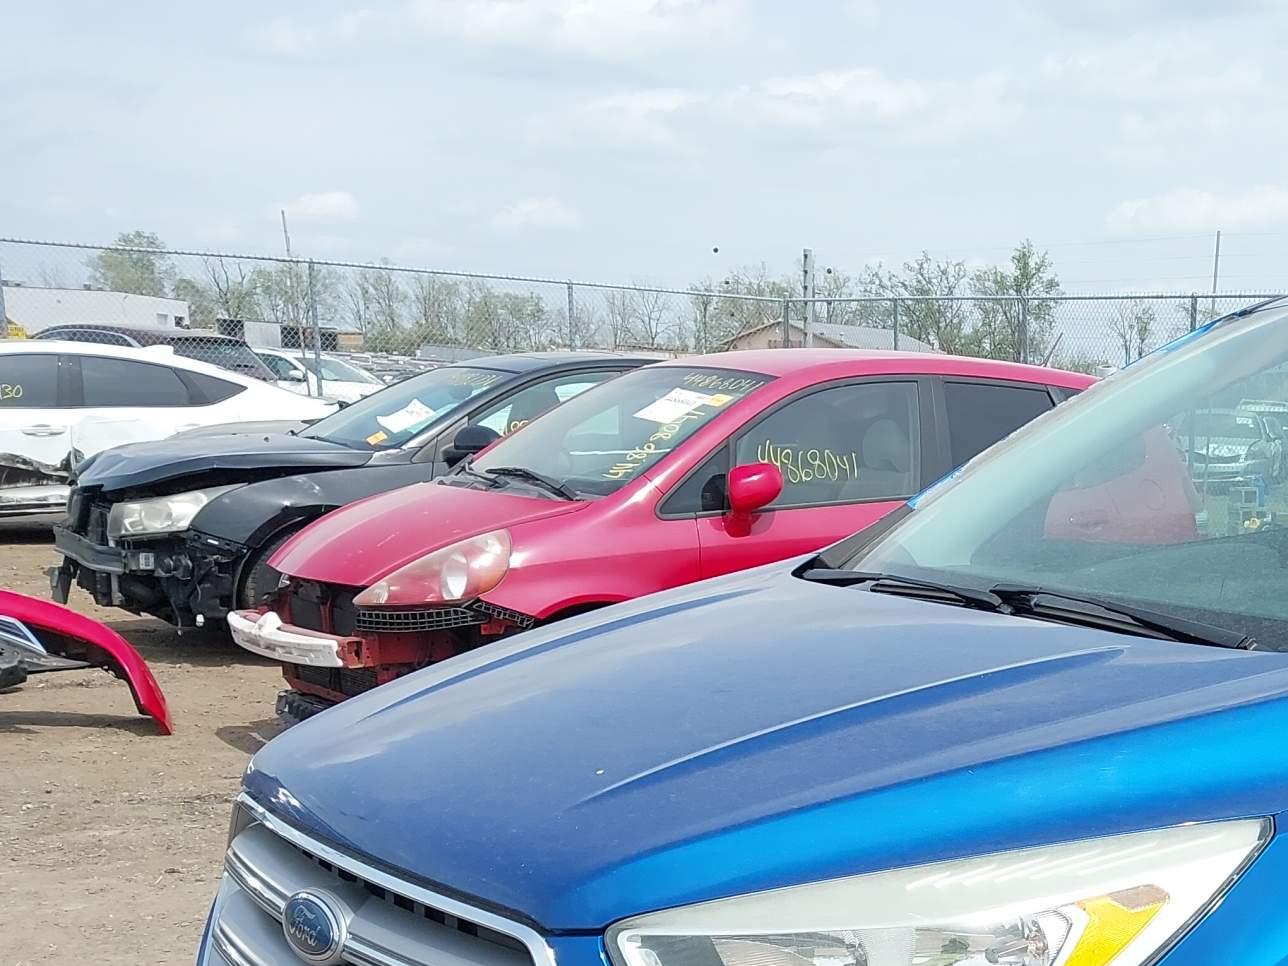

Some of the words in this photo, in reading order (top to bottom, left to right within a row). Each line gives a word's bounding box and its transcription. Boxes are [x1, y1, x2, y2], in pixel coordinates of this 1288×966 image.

[0, 383, 23, 400] 30
[757, 439, 858, 483] 44868041
[289, 904, 322, 946] Ford
